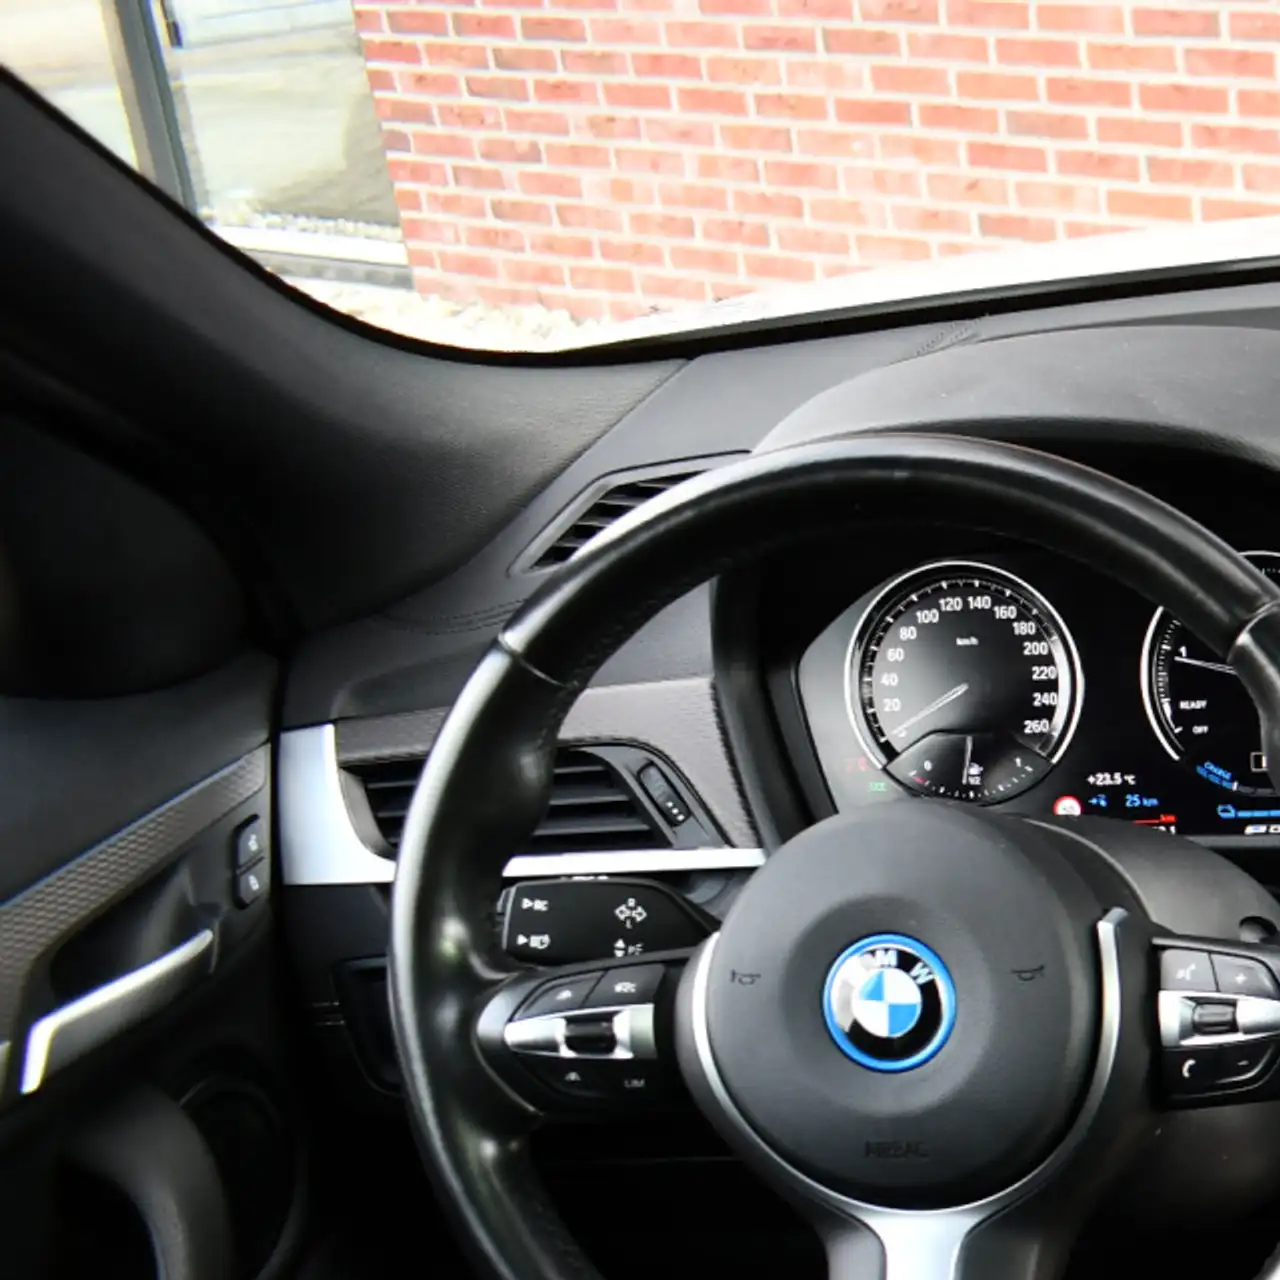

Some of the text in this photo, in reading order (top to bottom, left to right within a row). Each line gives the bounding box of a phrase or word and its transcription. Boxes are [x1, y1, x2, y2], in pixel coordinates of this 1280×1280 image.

[939, 597, 963, 611] 120
[967, 595, 992, 610] 140
[916, 608, 939, 624] 100
[993, 605, 1017, 620] 160
[899, 626, 917, 641] 80
[1012, 621, 1036, 636] 180
[886, 648, 905, 662] 60
[1023, 641, 1049, 656] 200
[880, 673, 899, 687] 40
[1031, 666, 1057, 681] 220
[883, 698, 901, 712] 20
[1032, 691, 1058, 707] 240
[1023, 719, 1050, 734] 260
[1192, 725, 1209, 735] OFF
[1125, 793, 1140, 807] 25
